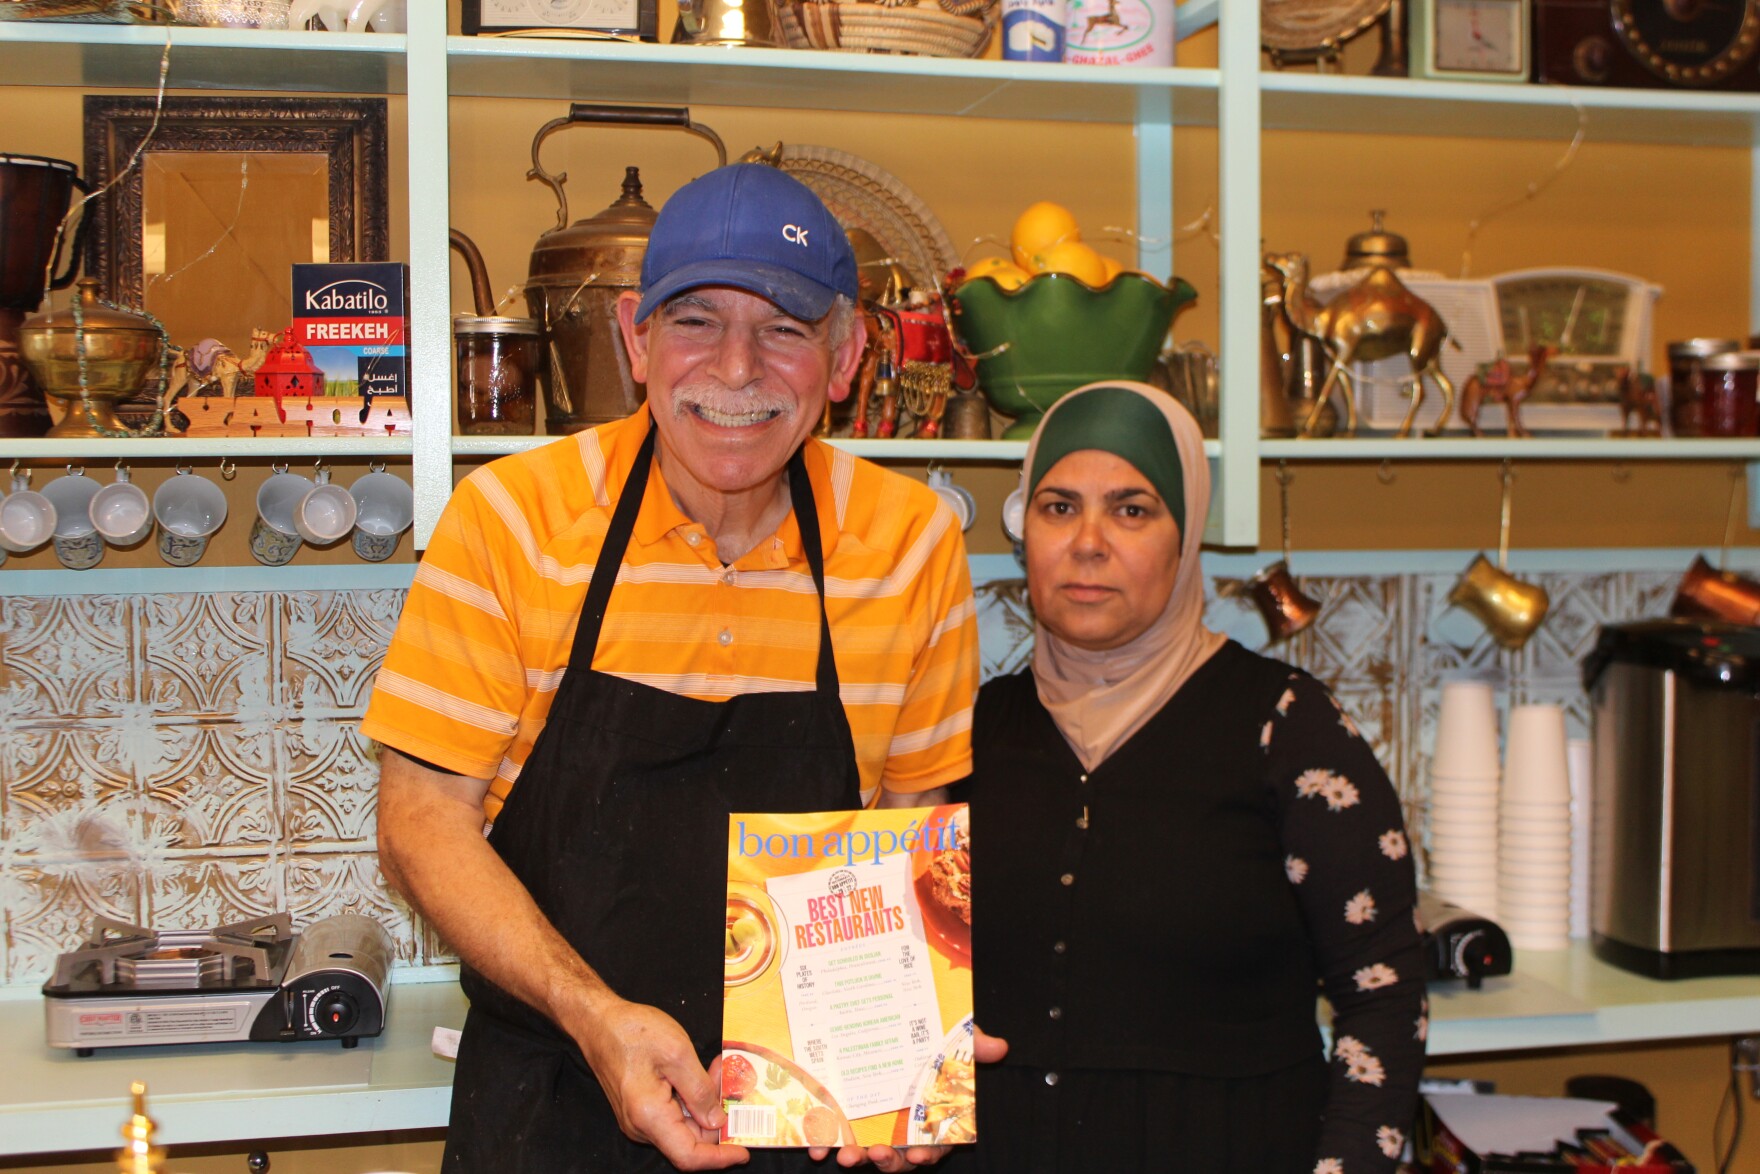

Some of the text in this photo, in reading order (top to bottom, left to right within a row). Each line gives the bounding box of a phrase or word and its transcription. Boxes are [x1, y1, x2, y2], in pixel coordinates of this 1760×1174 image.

[782, 223, 809, 247] CK
[305, 288, 388, 310] Kabatilo
[306, 322, 389, 339] FREEKEH
[363, 347, 389, 355] COARSE
[736, 816, 962, 867] bon appétit
[807, 885, 884, 922] BEST NEW
[794, 905, 905, 949] RESTAURANTS
